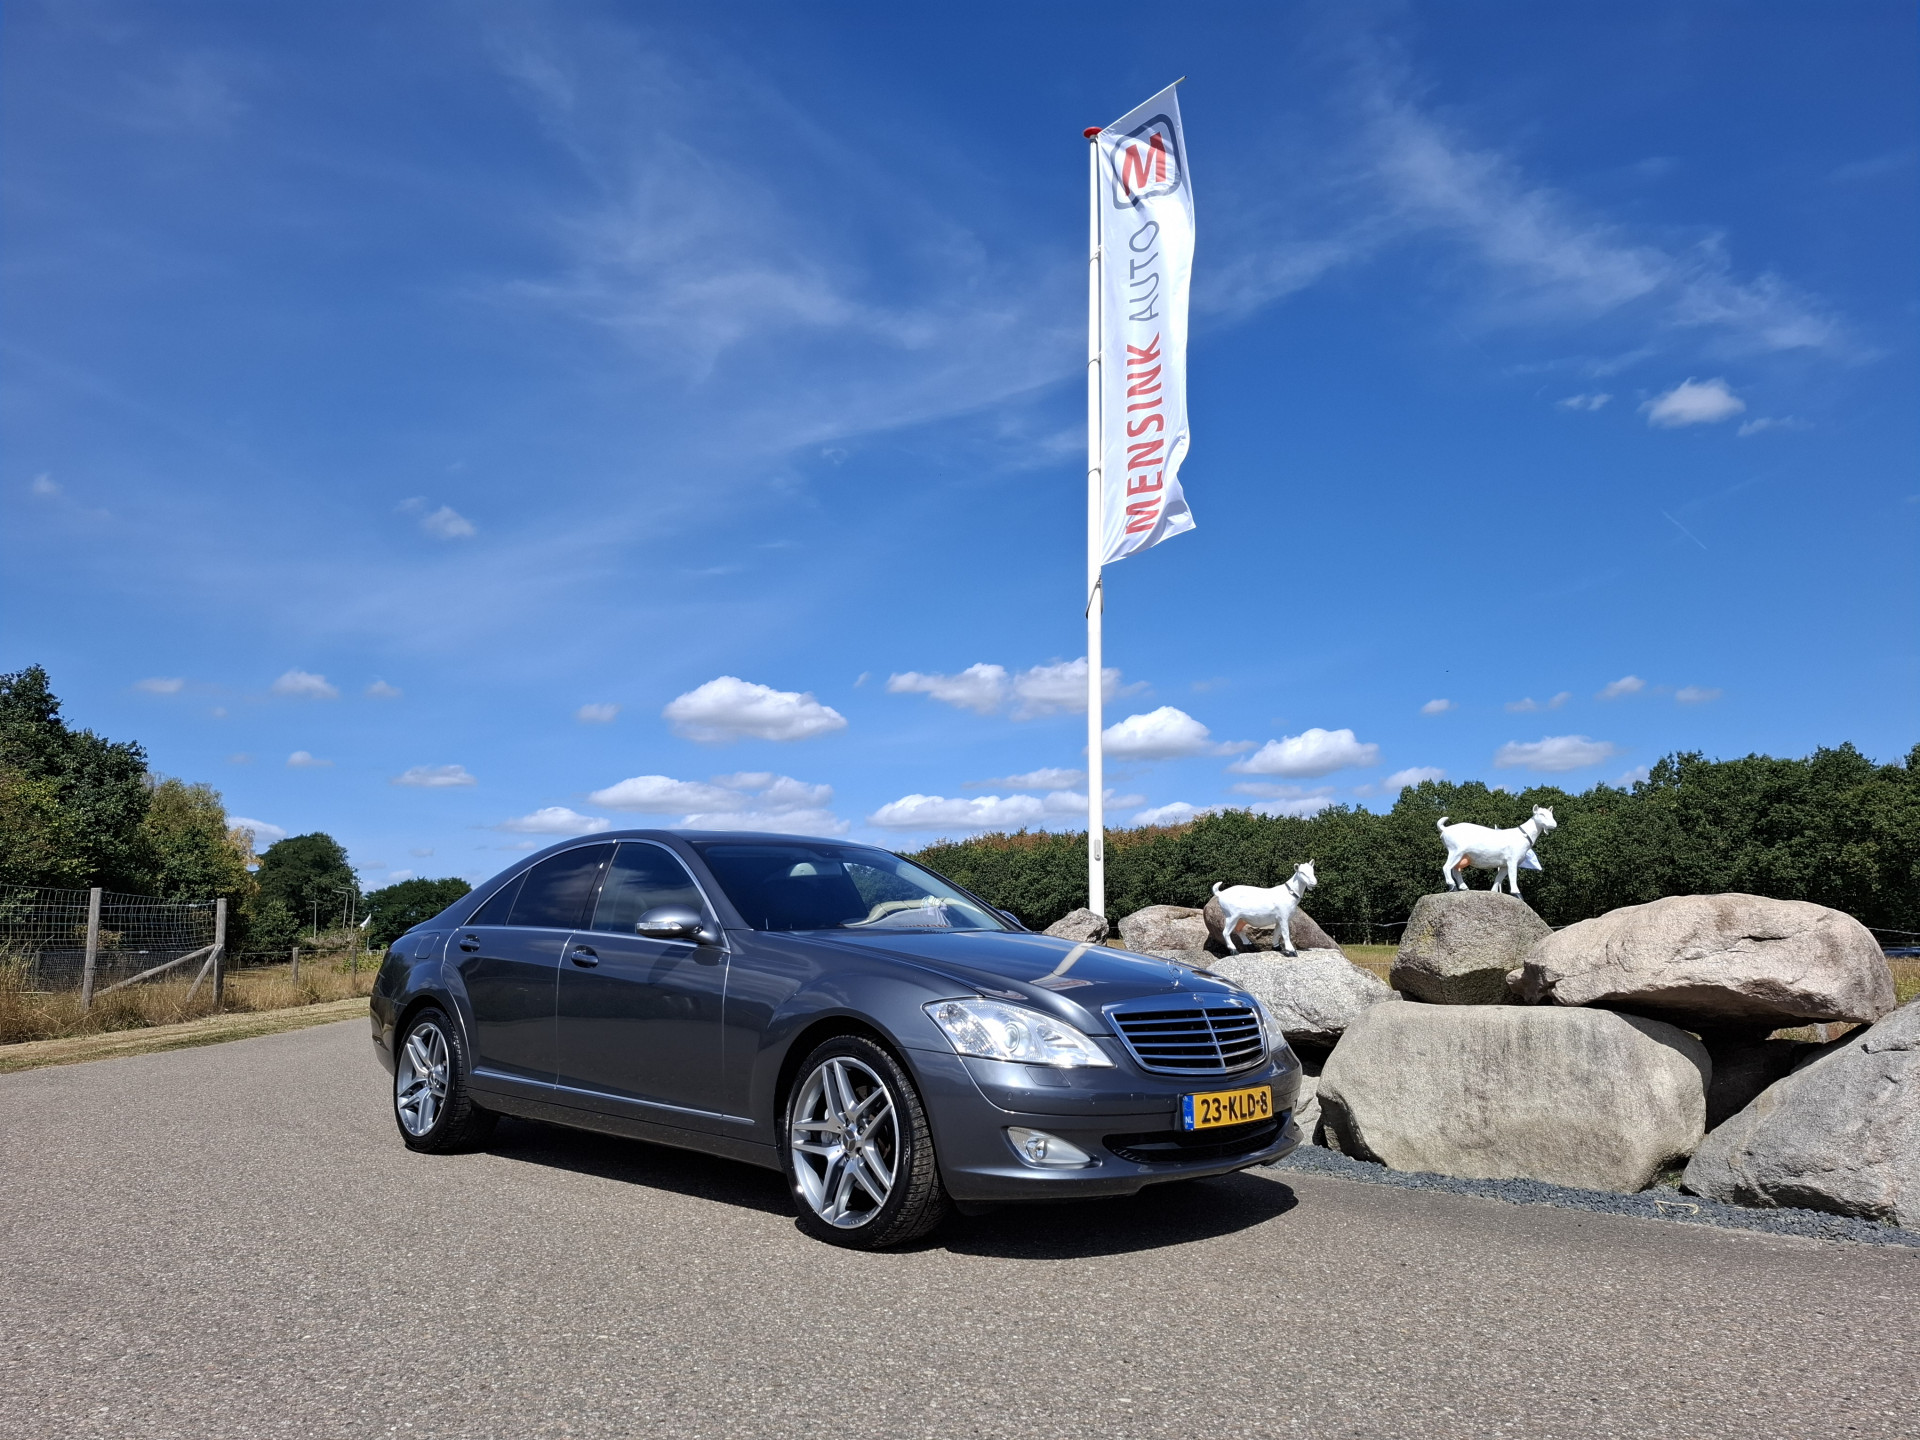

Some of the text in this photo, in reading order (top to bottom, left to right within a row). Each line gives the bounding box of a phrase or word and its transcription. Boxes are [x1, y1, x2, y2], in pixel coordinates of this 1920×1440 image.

[1122, 131, 1166, 196] M
[1125, 220, 1165, 535] MENSINK AUTO
[1185, 1115, 1193, 1124] NL
[1201, 1090, 1268, 1124] 23-KLD-8
